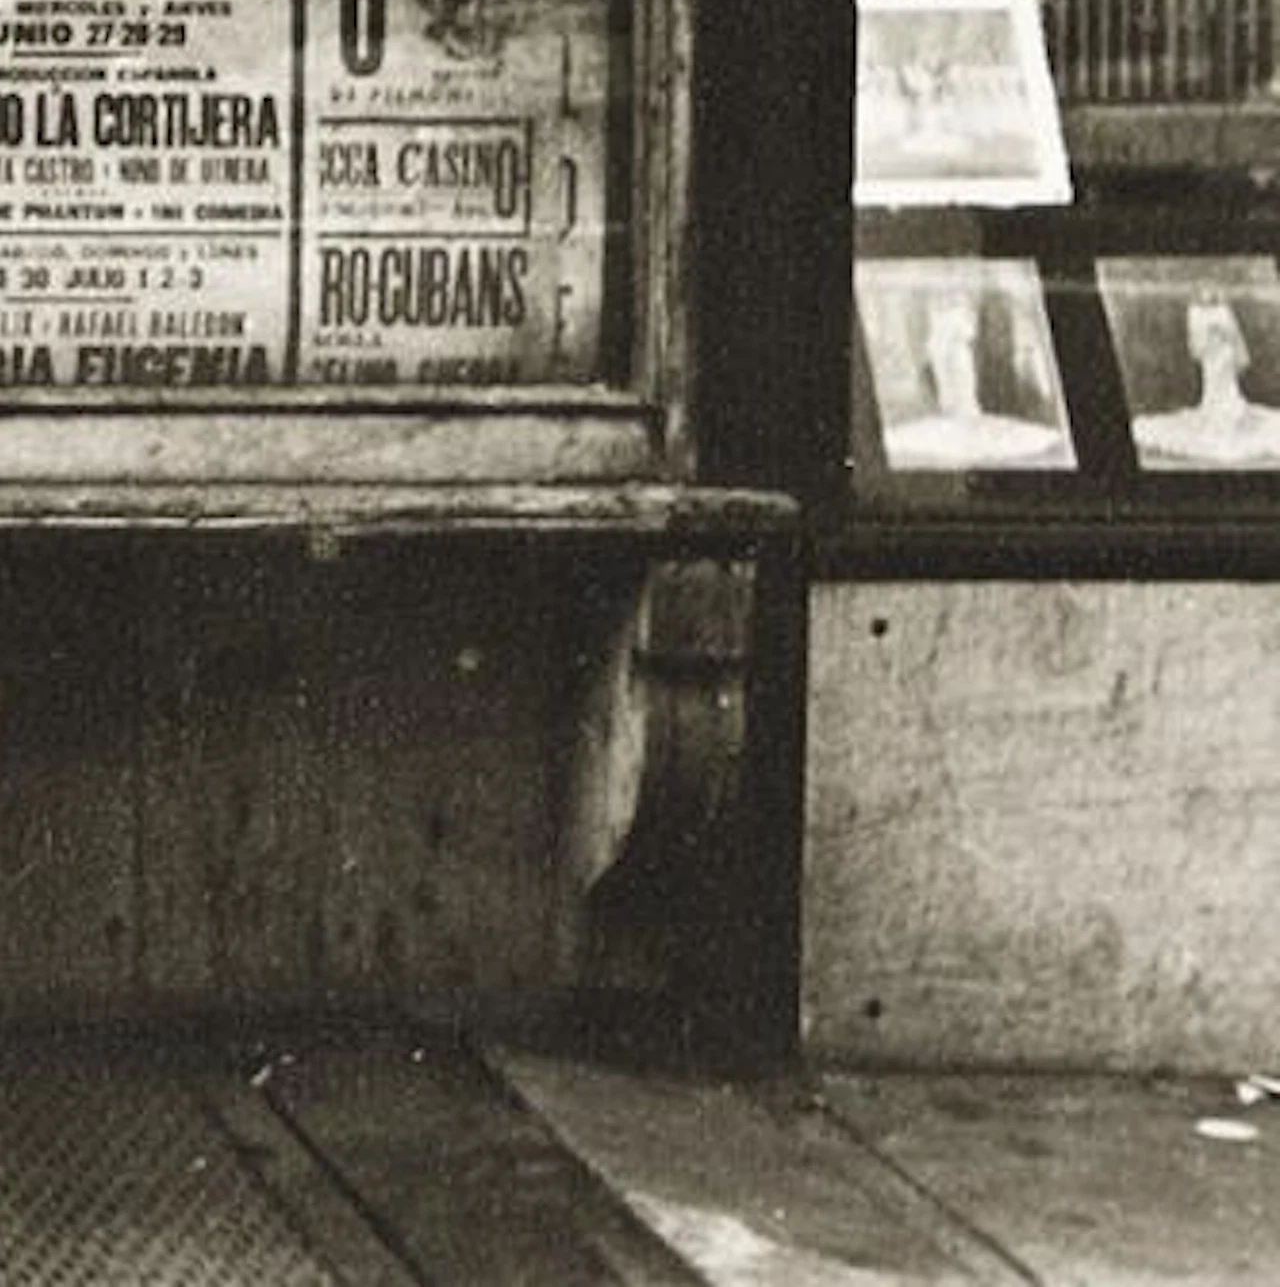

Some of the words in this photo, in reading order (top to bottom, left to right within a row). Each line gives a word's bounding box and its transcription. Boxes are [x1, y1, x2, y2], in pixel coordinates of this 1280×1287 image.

[35, 93, 79, 148] LA
[92, 93, 281, 149] CORTIJERA
[319, 141, 381, 188] CCA
